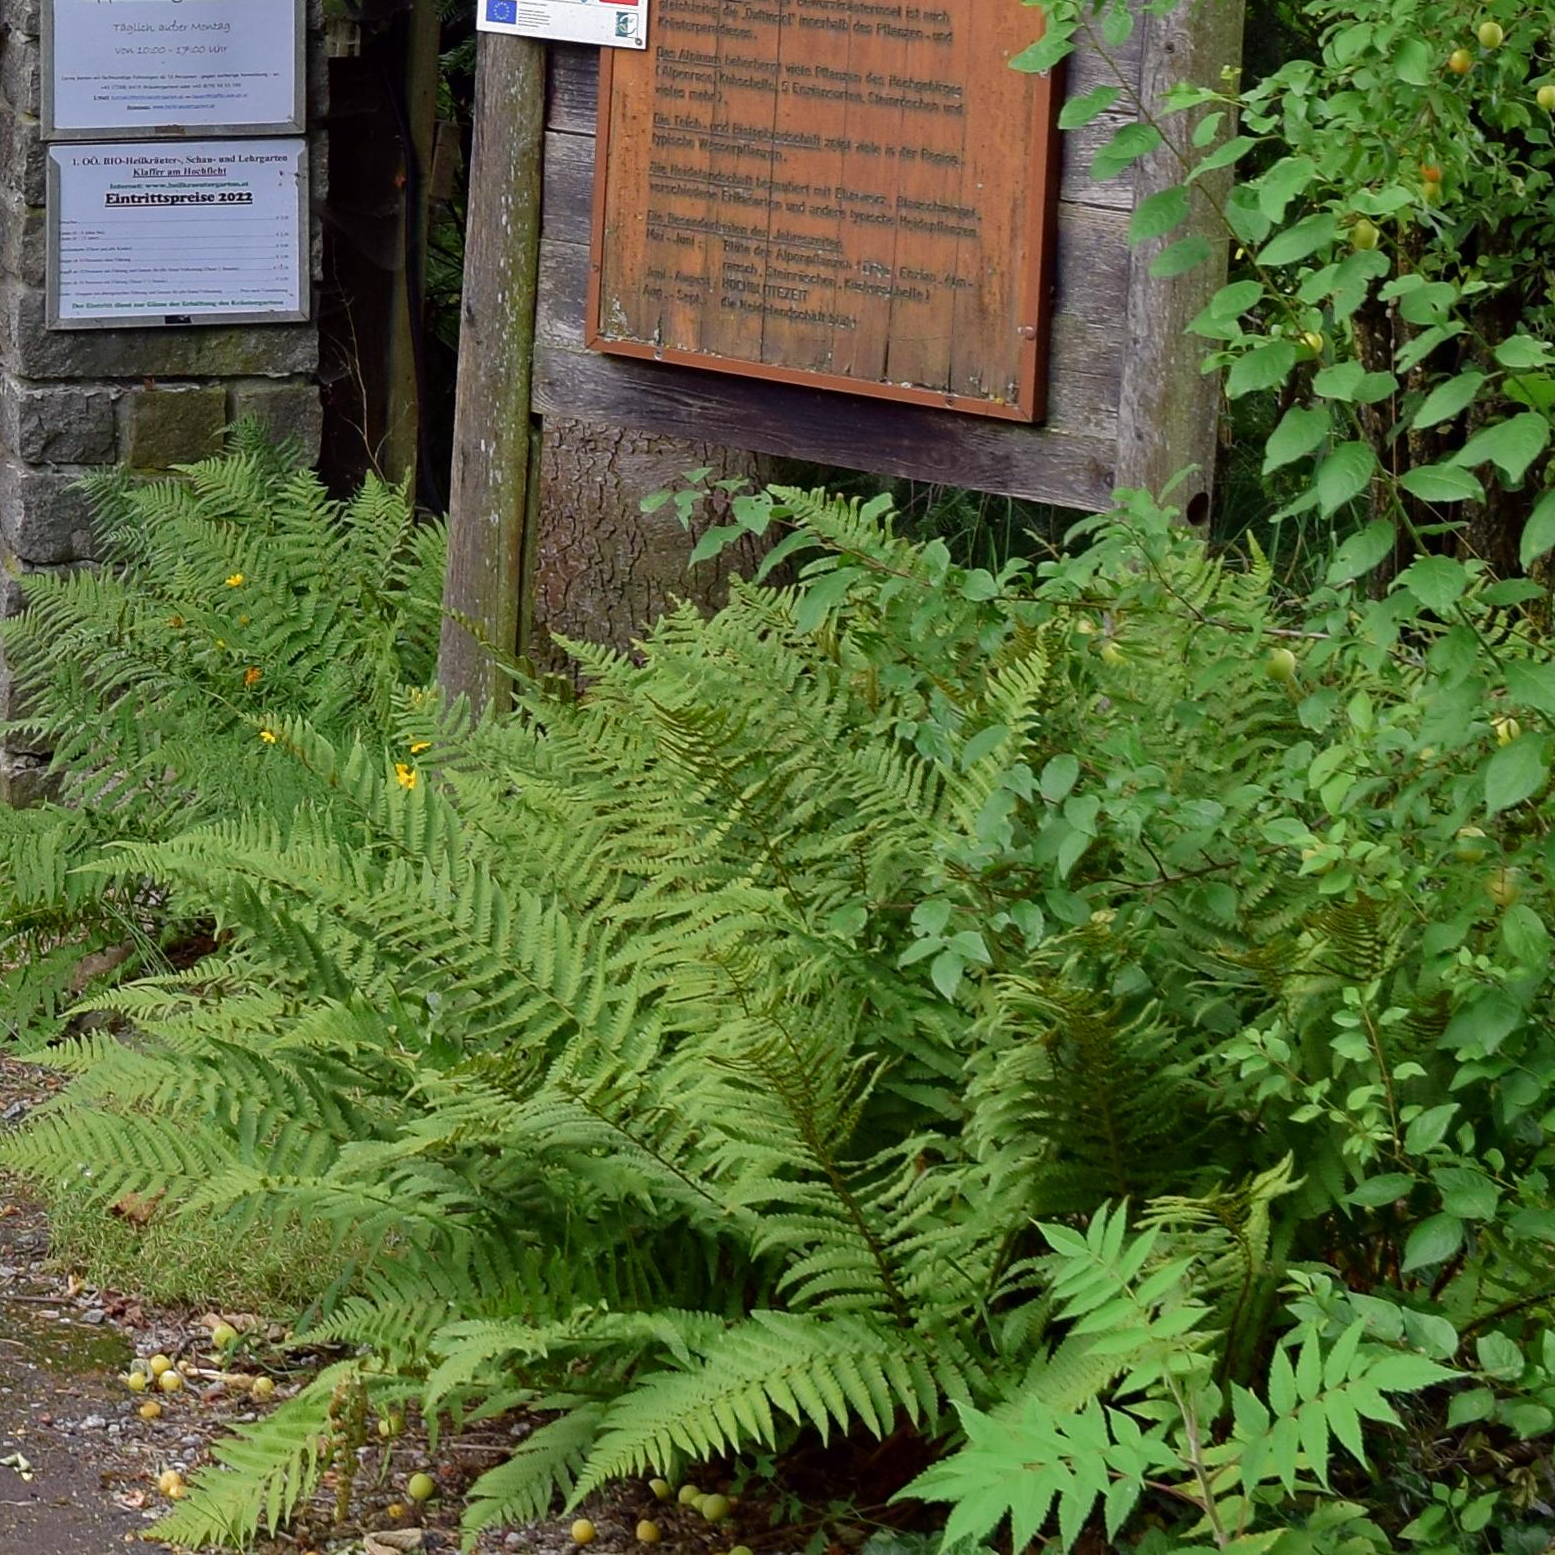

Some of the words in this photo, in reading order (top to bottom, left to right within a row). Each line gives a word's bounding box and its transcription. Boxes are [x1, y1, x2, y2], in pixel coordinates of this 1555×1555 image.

[905, 5, 920, 19] ist
[113, 23, 154, 34] Täglich
[191, 22, 231, 33] Montag
[655, 45, 676, 59] Das
[784, 63, 811, 77] viele
[814, 65, 862, 83] Pflanzen
[219, 155, 235, 163] und
[238, 154, 289, 165] Lehrgarten
[133, 168, 164, 177] Klaffer
[167, 169, 181, 177] am
[184, 167, 227, 176] Hochficht
[105, 192, 215, 206] Eintrittspreise
[219, 191, 253, 203] 2022
